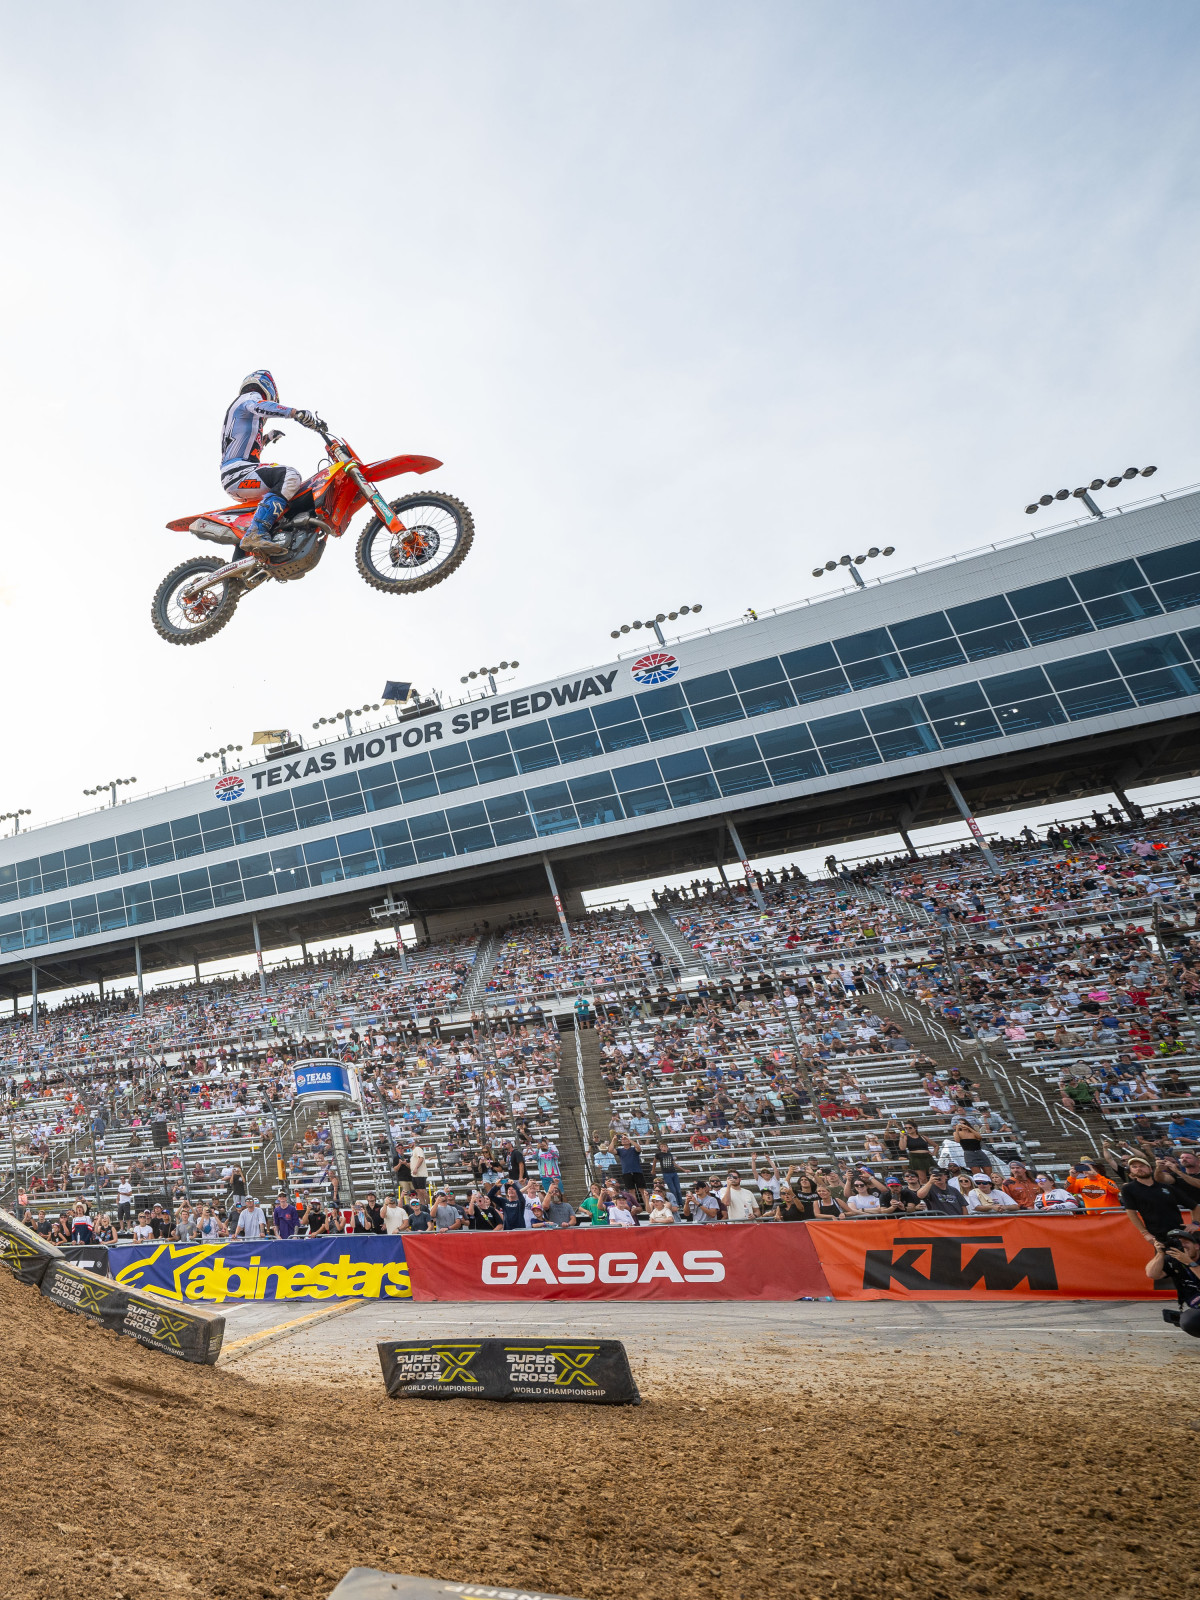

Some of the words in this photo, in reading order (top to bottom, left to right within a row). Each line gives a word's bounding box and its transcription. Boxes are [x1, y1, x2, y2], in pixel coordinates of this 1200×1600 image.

[238, 479, 261, 489] KTM
[251, 751, 337, 790] TEXAS
[343, 722, 444, 765] MOTOR
[452, 669, 620, 733] SPEEDWAY
[306, 1072, 332, 1082] TEXAS
[481, 1250, 725, 1286] GASGAS
[862, 1236, 1059, 1291] KTM
[54, 1273, 85, 1292] SUPER
[183, 1255, 414, 1304] alpinestars
[50, 1287, 81, 1304] CROSS
[54, 1281, 82, 1297] MOTO
[126, 1303, 161, 1322] SUPER
[126, 1311, 158, 1328] MOTO
[123, 1317, 157, 1335] CROSS
[122, 1327, 142, 1340] WORLD
[142, 1335, 185, 1357] CHAMPIONSHIP
[397, 1354, 441, 1364] SUPER
[506, 1354, 556, 1364] SUPER
[401, 1363, 440, 1372] MOTO
[511, 1364, 555, 1373] MOTO
[399, 1371, 442, 1381] CROSS
[509, 1373, 558, 1383] CROSS
[427, 1384, 485, 1393] CHAMPIONSHIP
[513, 1387, 542, 1395] WORLD
[543, 1387, 606, 1397] CHAMPIONSHIP
